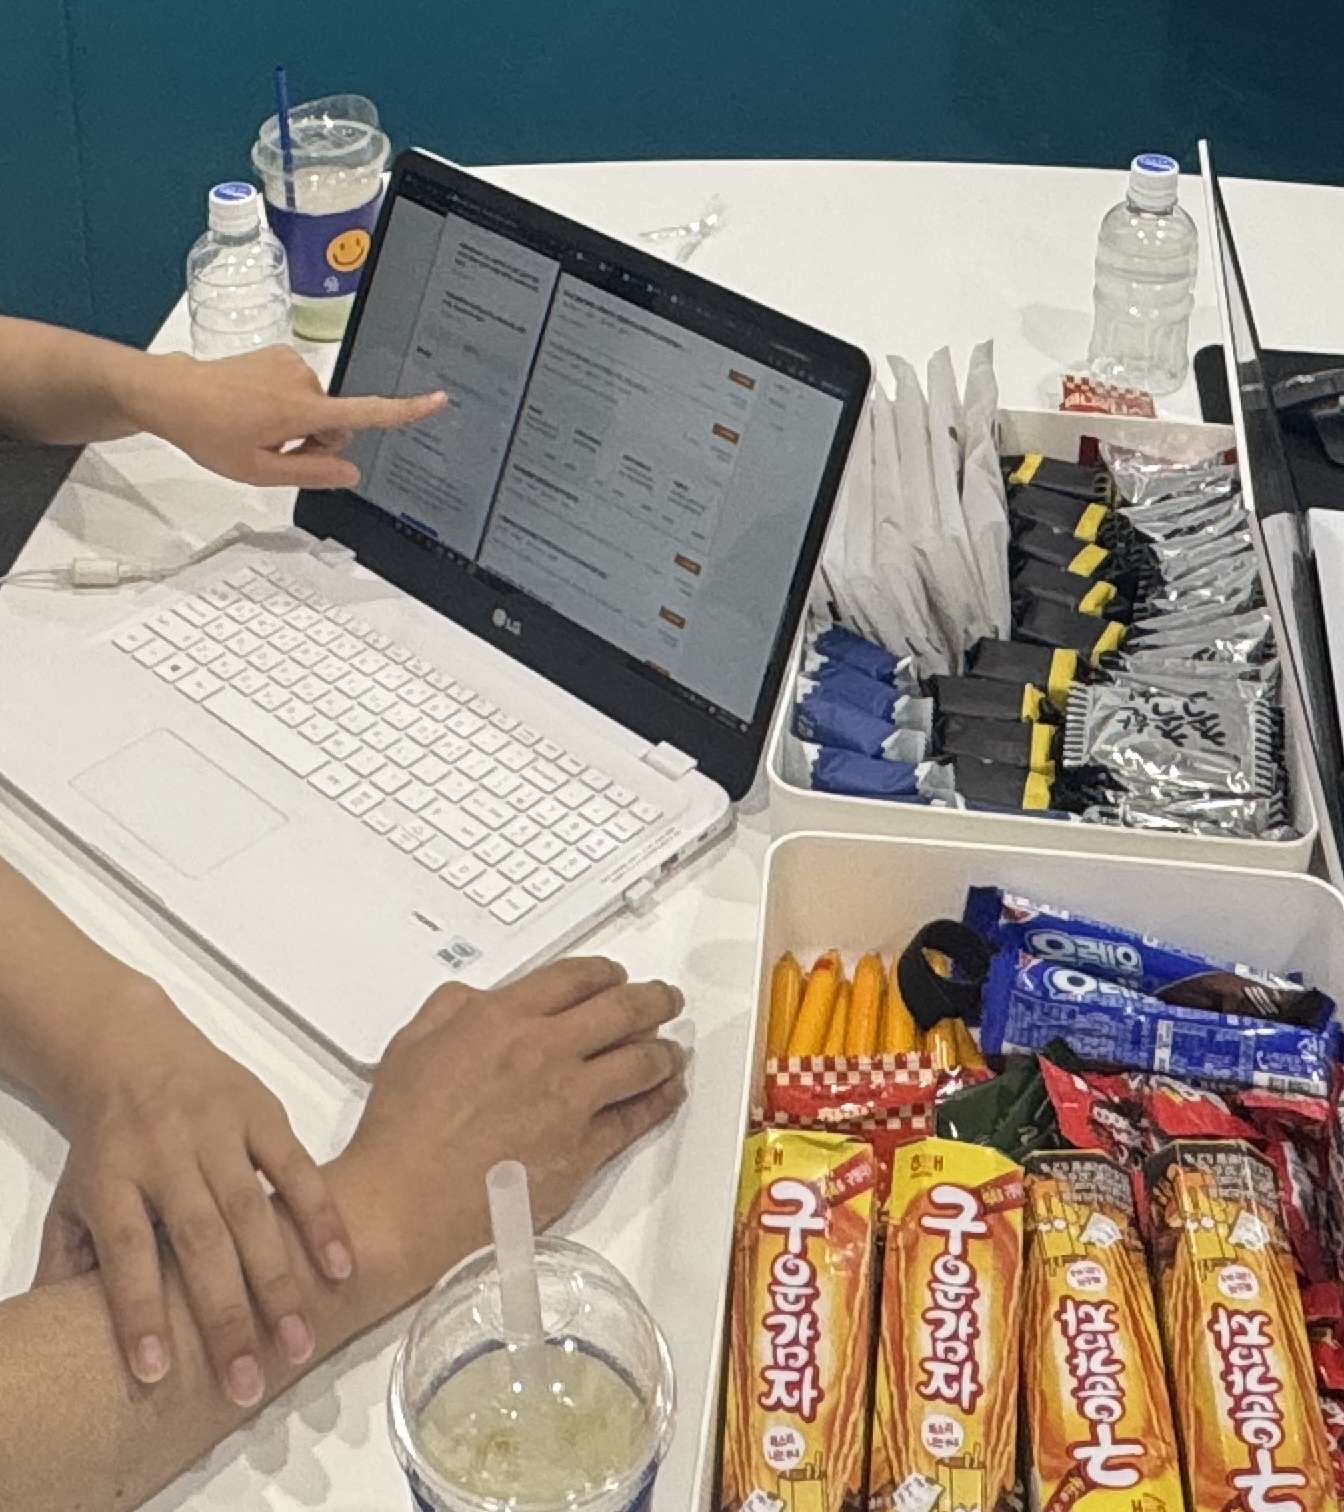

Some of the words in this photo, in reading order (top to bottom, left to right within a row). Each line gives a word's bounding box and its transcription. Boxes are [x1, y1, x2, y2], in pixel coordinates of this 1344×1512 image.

[1031, 932, 1140, 972] 오레오
[759, 1179, 827, 1420] 구운감자
[919, 1184, 989, 1413] 구운감자
[1060, 1298, 1146, 1487] 구운감자
[1212, 1306, 1307, 1512] 구운감자
